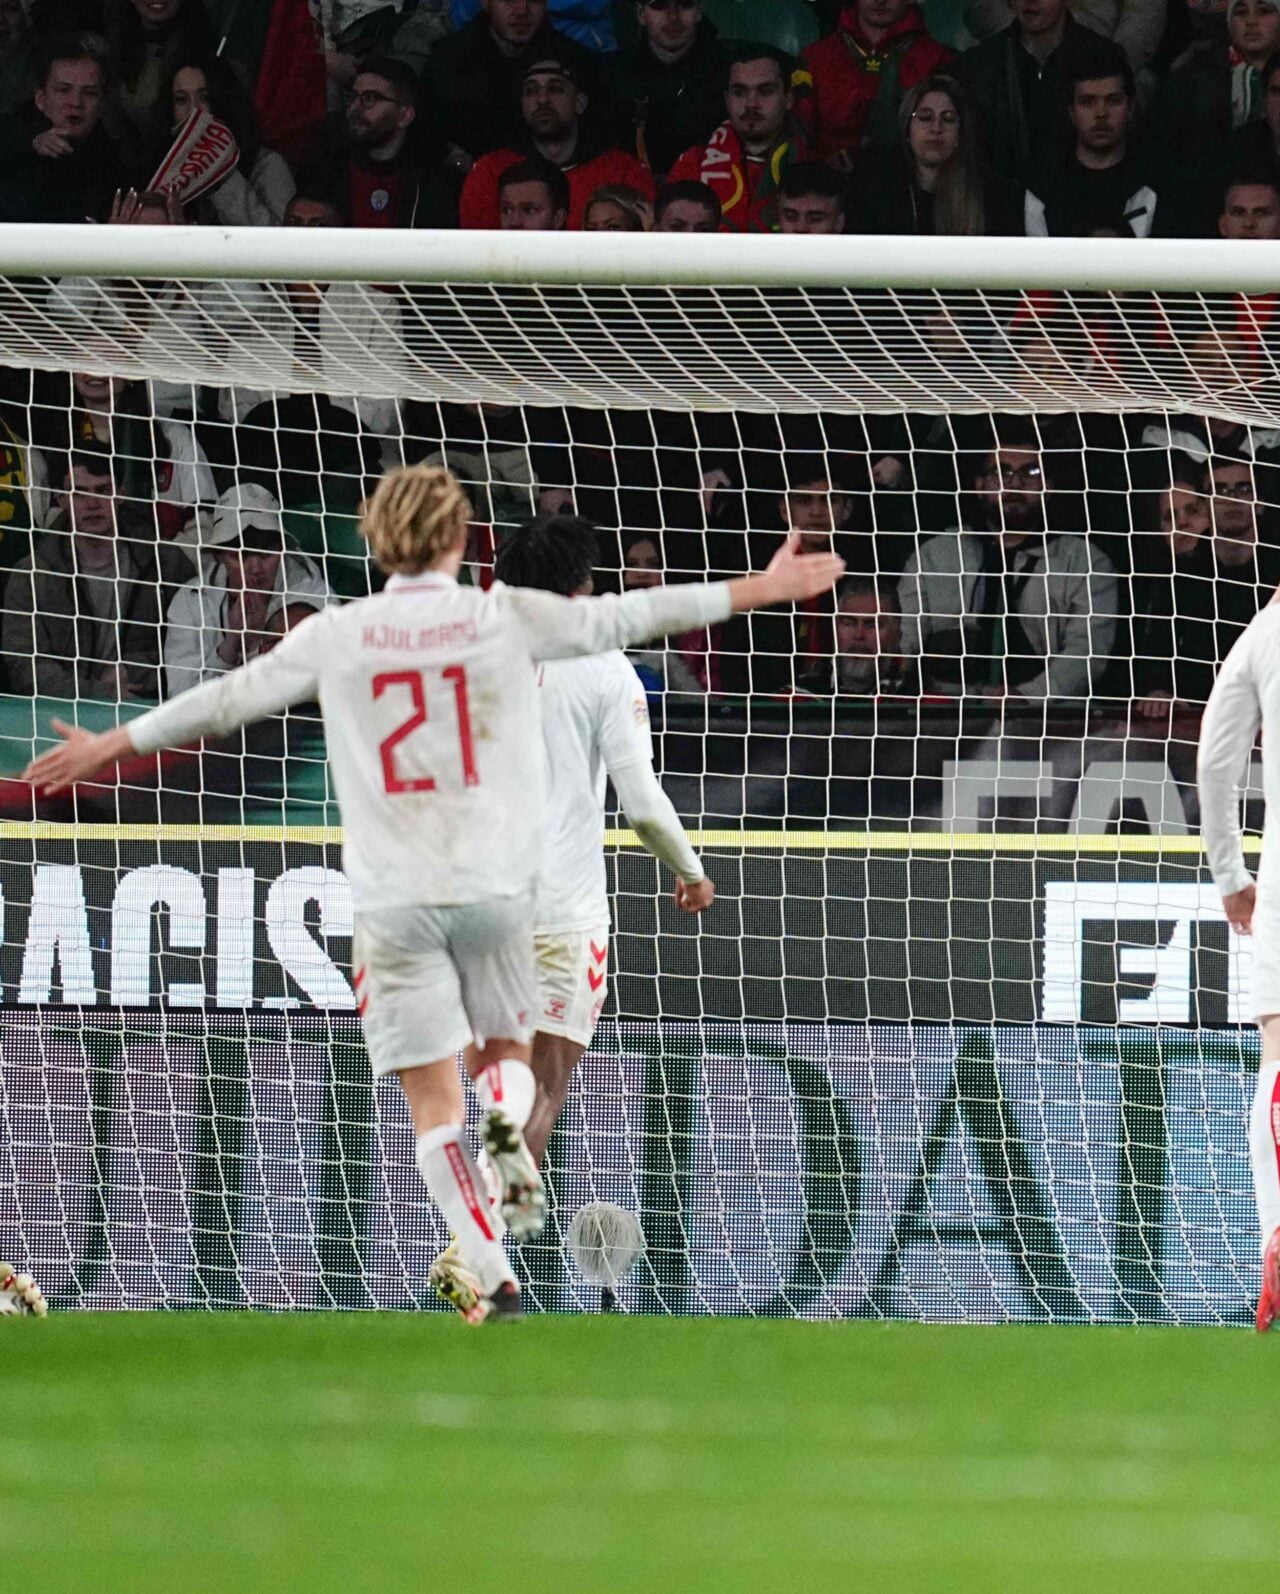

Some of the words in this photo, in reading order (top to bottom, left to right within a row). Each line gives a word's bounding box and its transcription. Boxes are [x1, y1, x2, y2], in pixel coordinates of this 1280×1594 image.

[701, 120, 731, 186] GAL
[372, 664, 479, 793] 21
[0, 864, 356, 1010] ACIS
